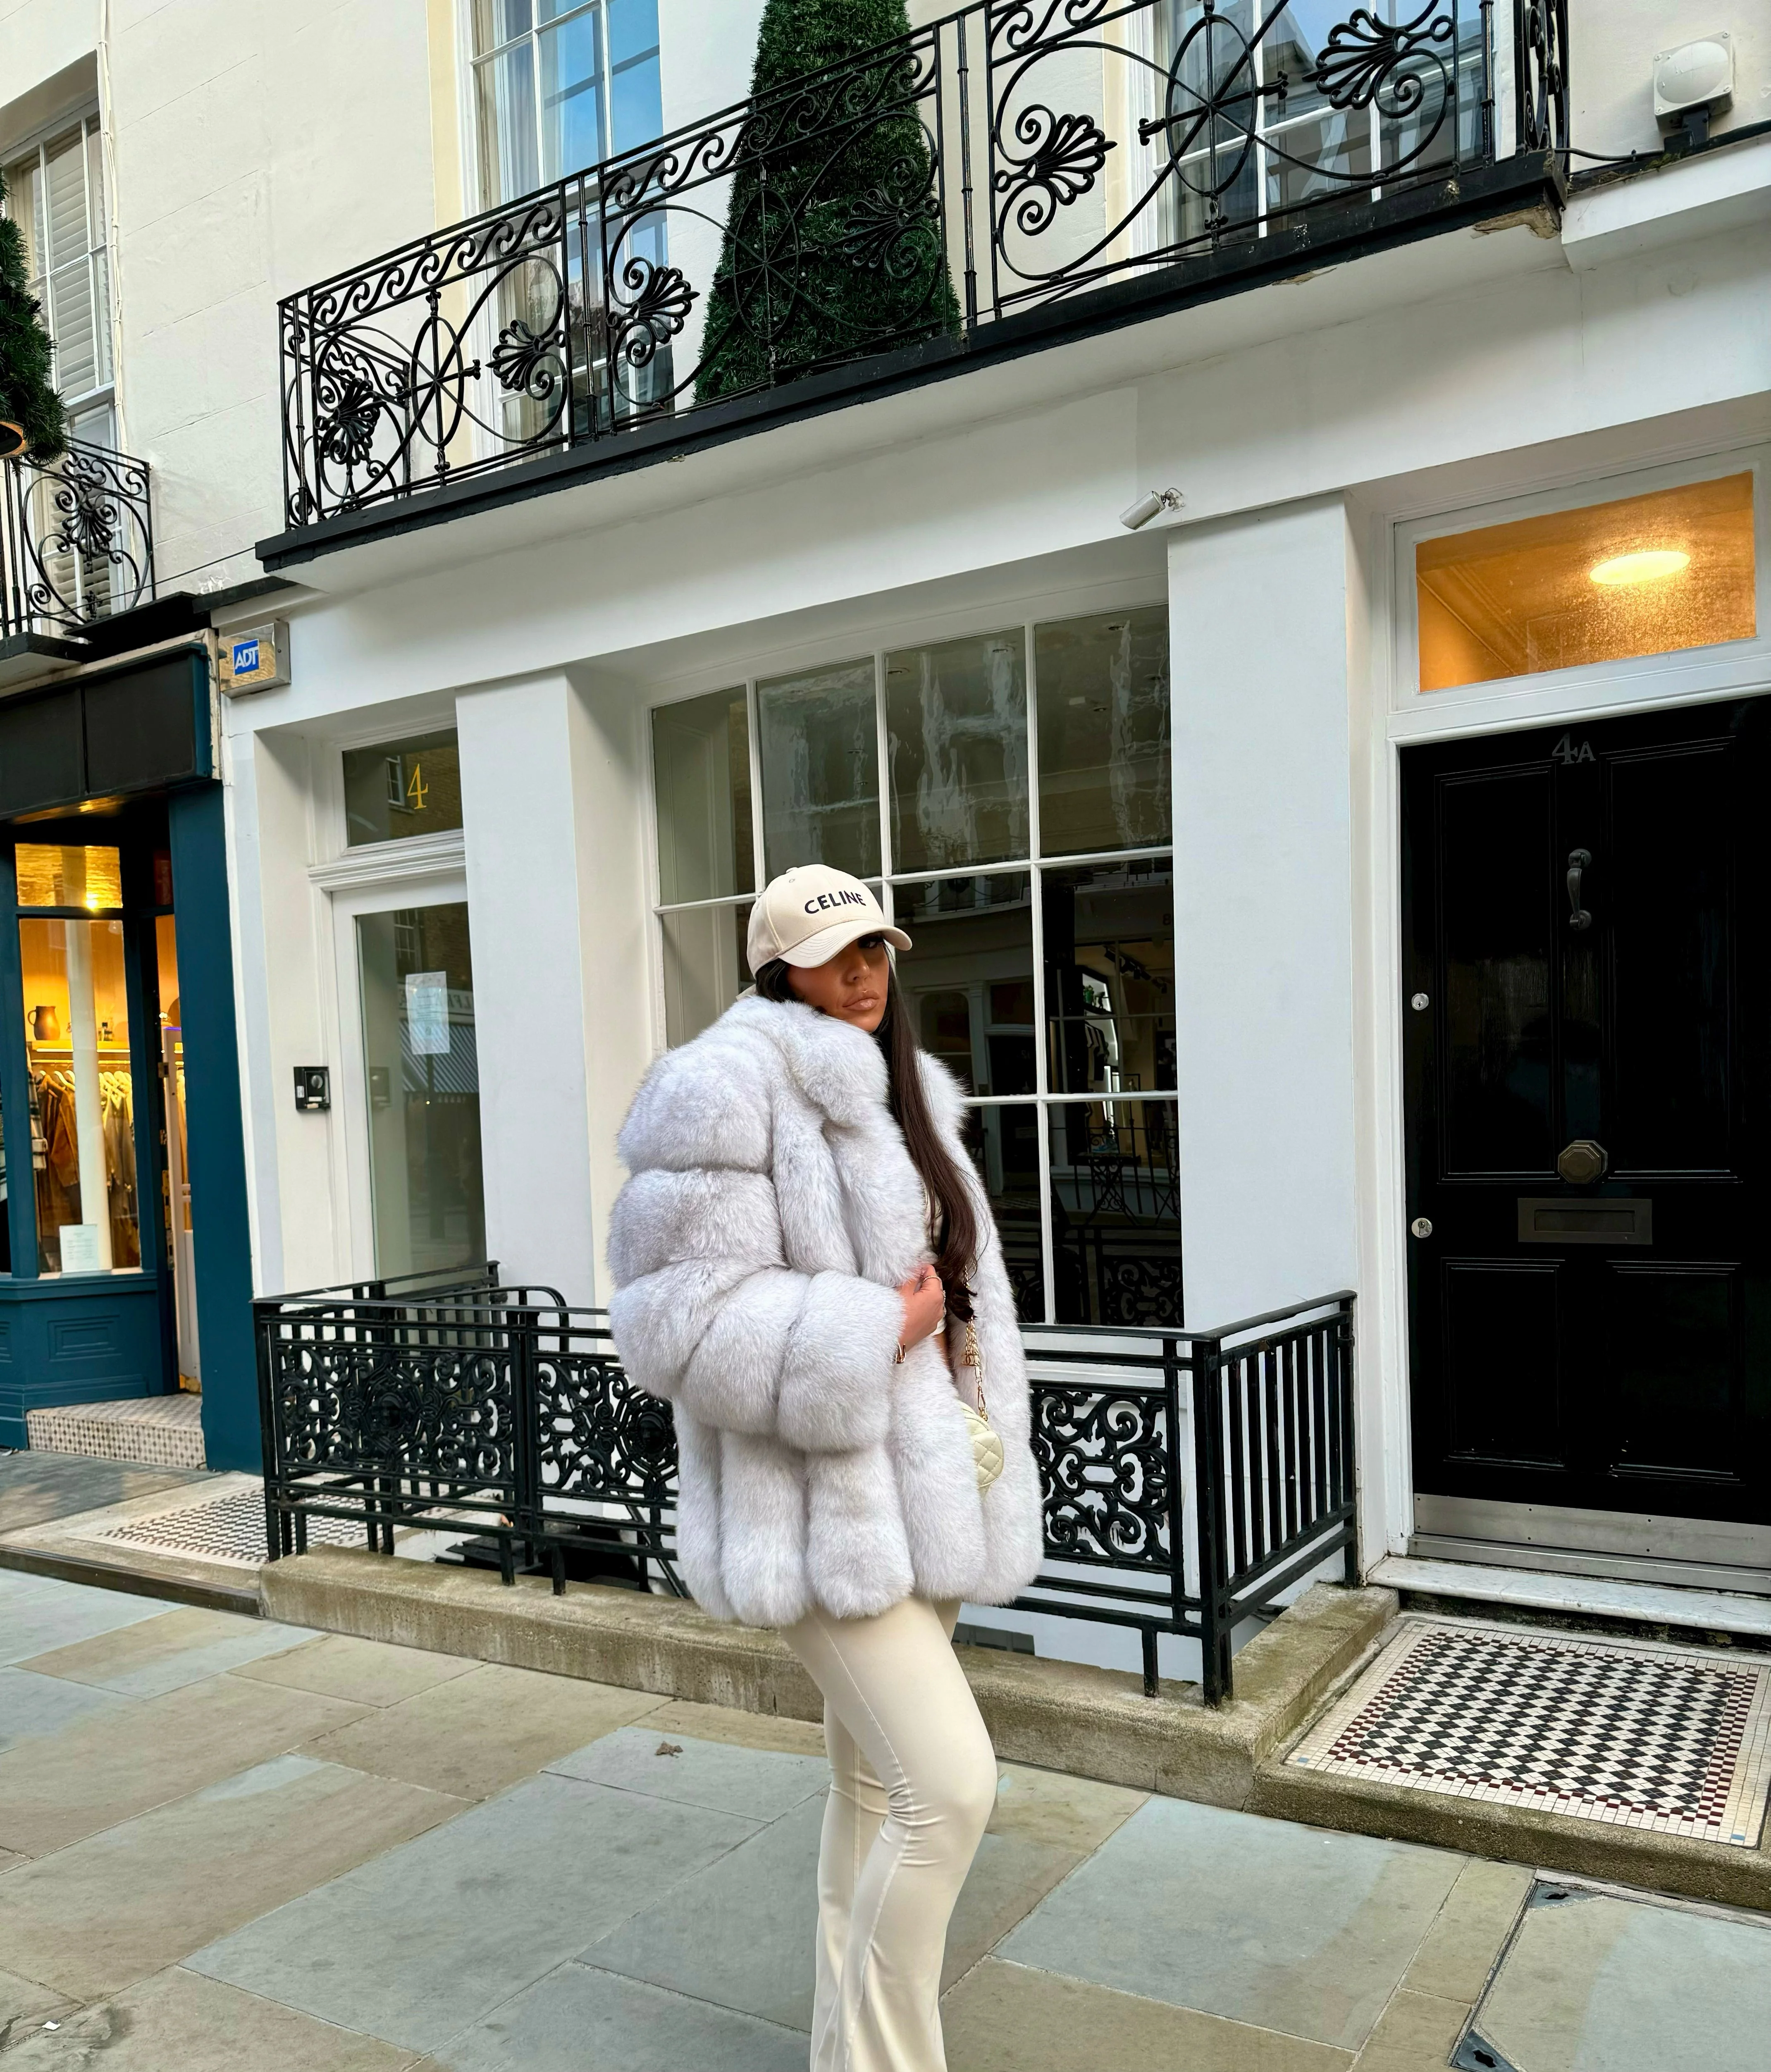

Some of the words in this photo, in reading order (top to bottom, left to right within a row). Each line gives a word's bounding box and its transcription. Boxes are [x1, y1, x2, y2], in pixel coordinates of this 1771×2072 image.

[235, 646, 259, 669] ADT
[1552, 732, 1596, 765] 4A
[407, 763, 428, 809] 4
[804, 890, 866, 914] CELINE
